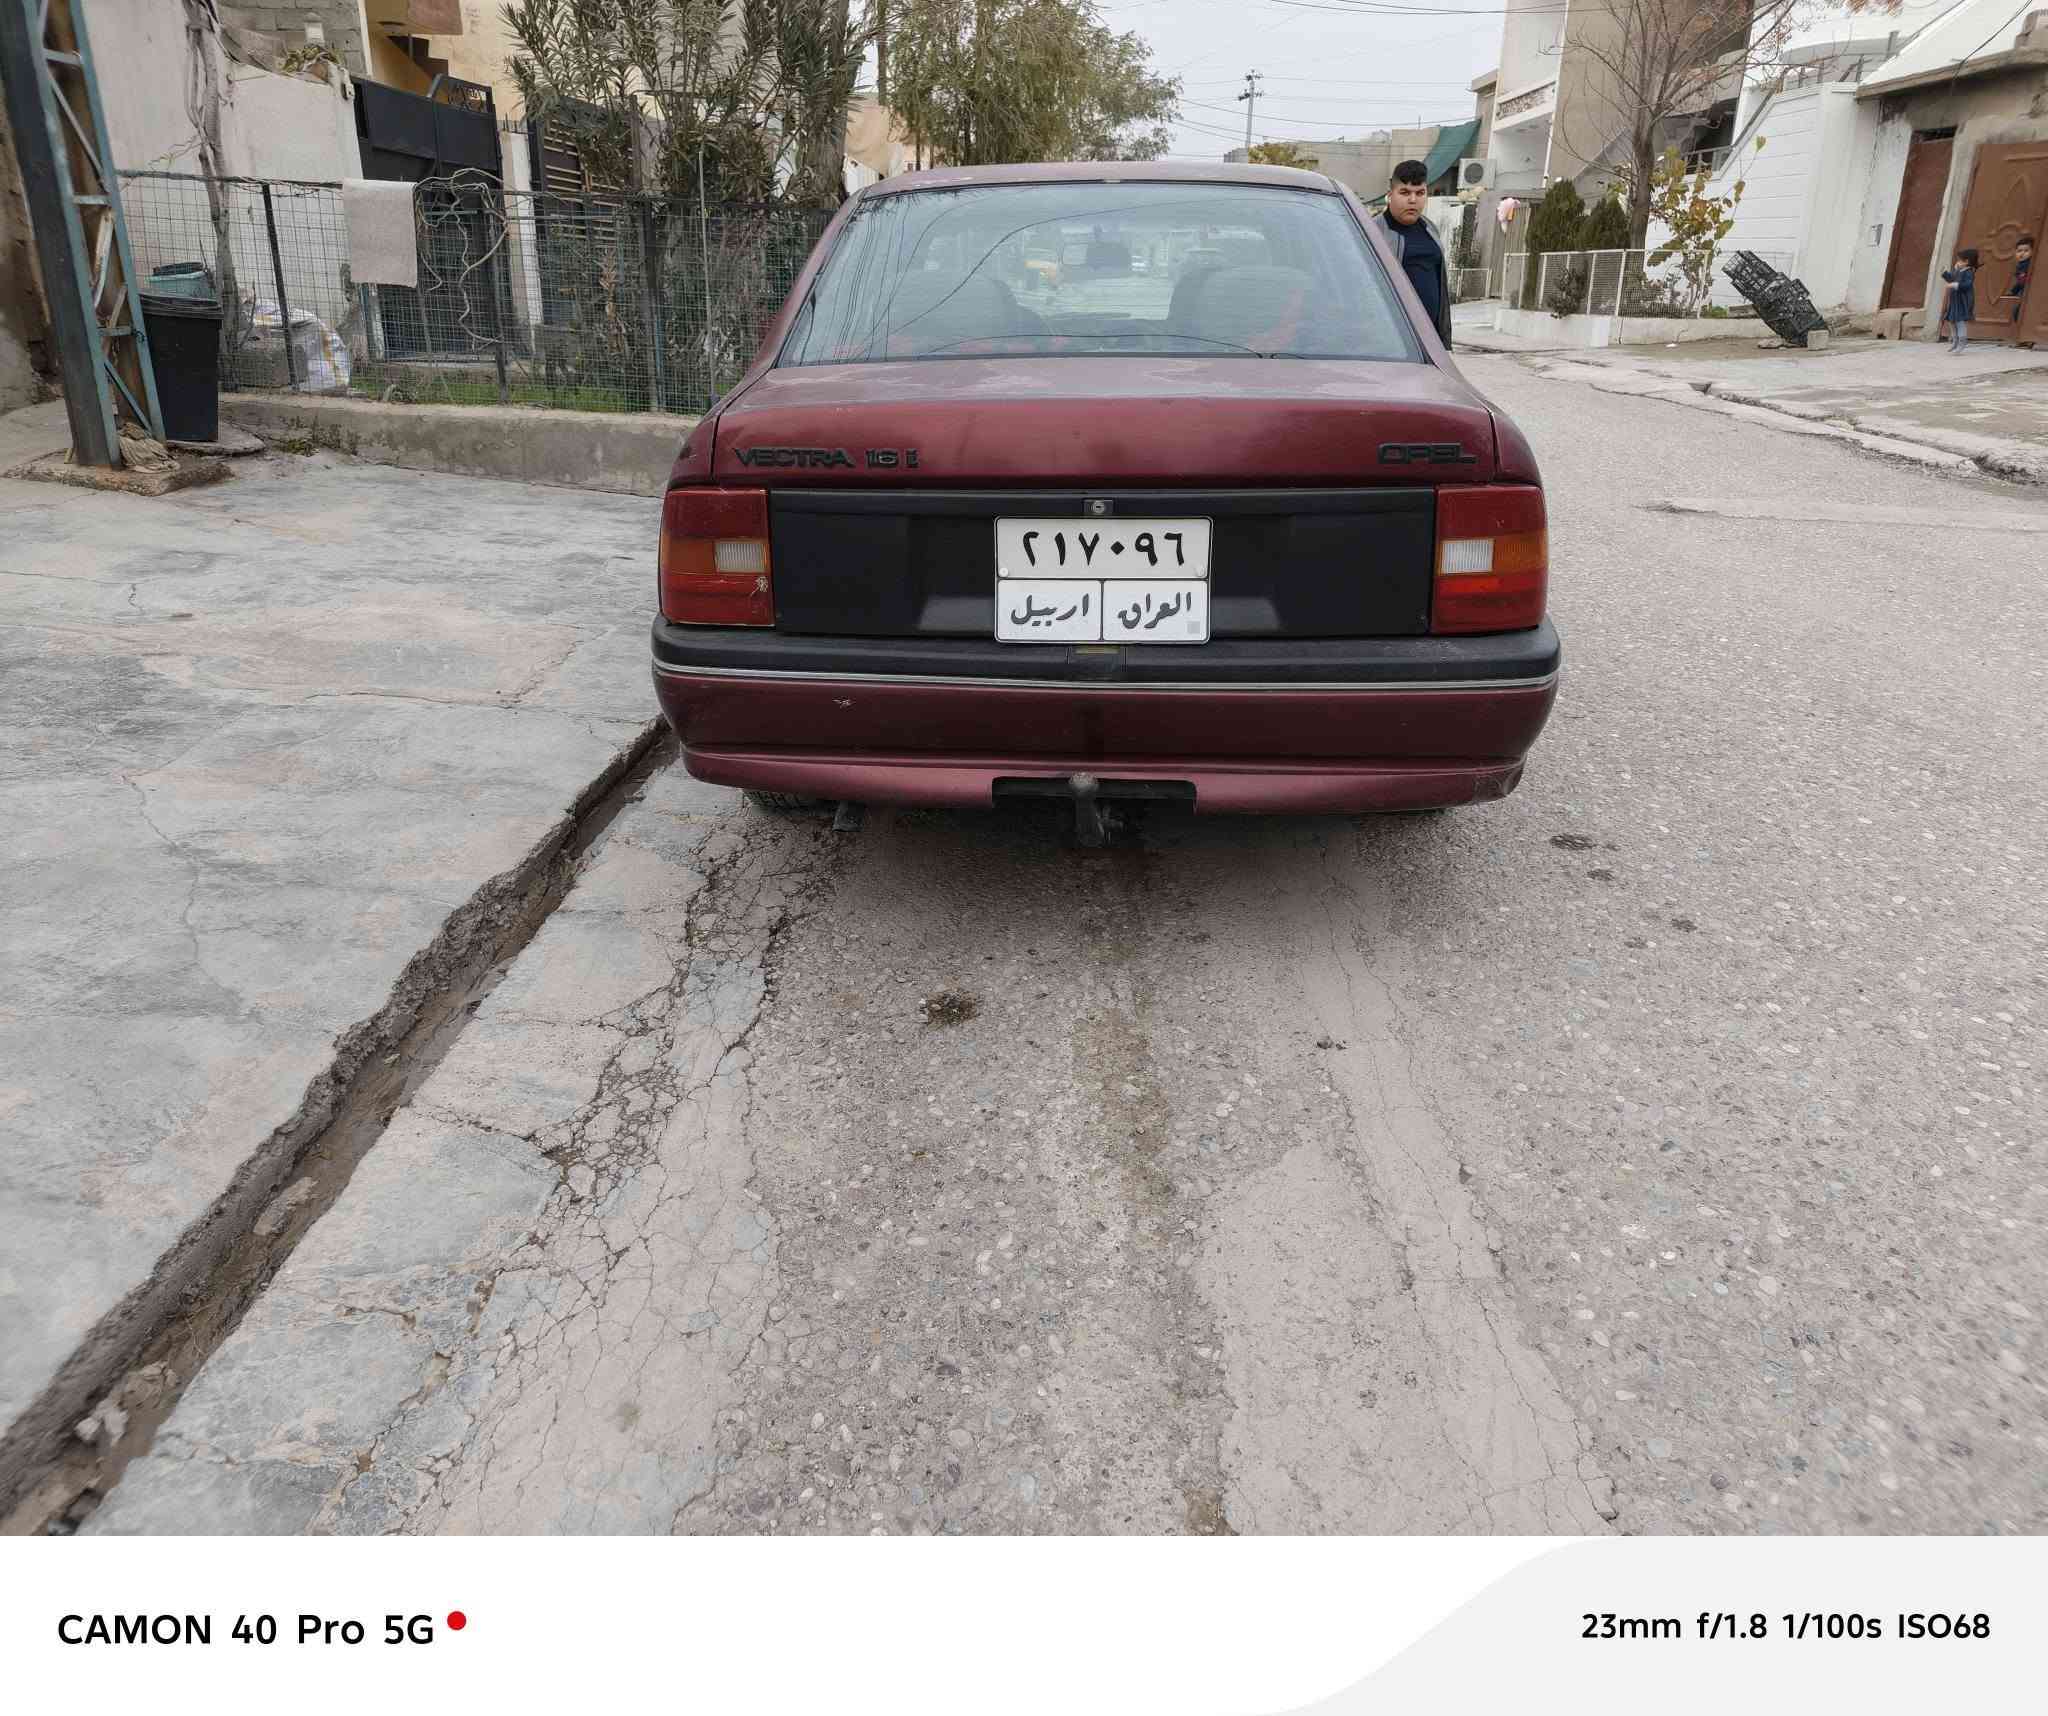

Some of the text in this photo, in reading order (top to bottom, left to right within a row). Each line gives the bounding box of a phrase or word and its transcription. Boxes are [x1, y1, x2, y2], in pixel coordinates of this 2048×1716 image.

[734, 448, 855, 468] VECTRA
[1377, 442, 1479, 465] OPEL
[1022, 531, 1185, 567] ٢١٧٠٩٦
[1010, 591, 1192, 630] العراق اربيل
